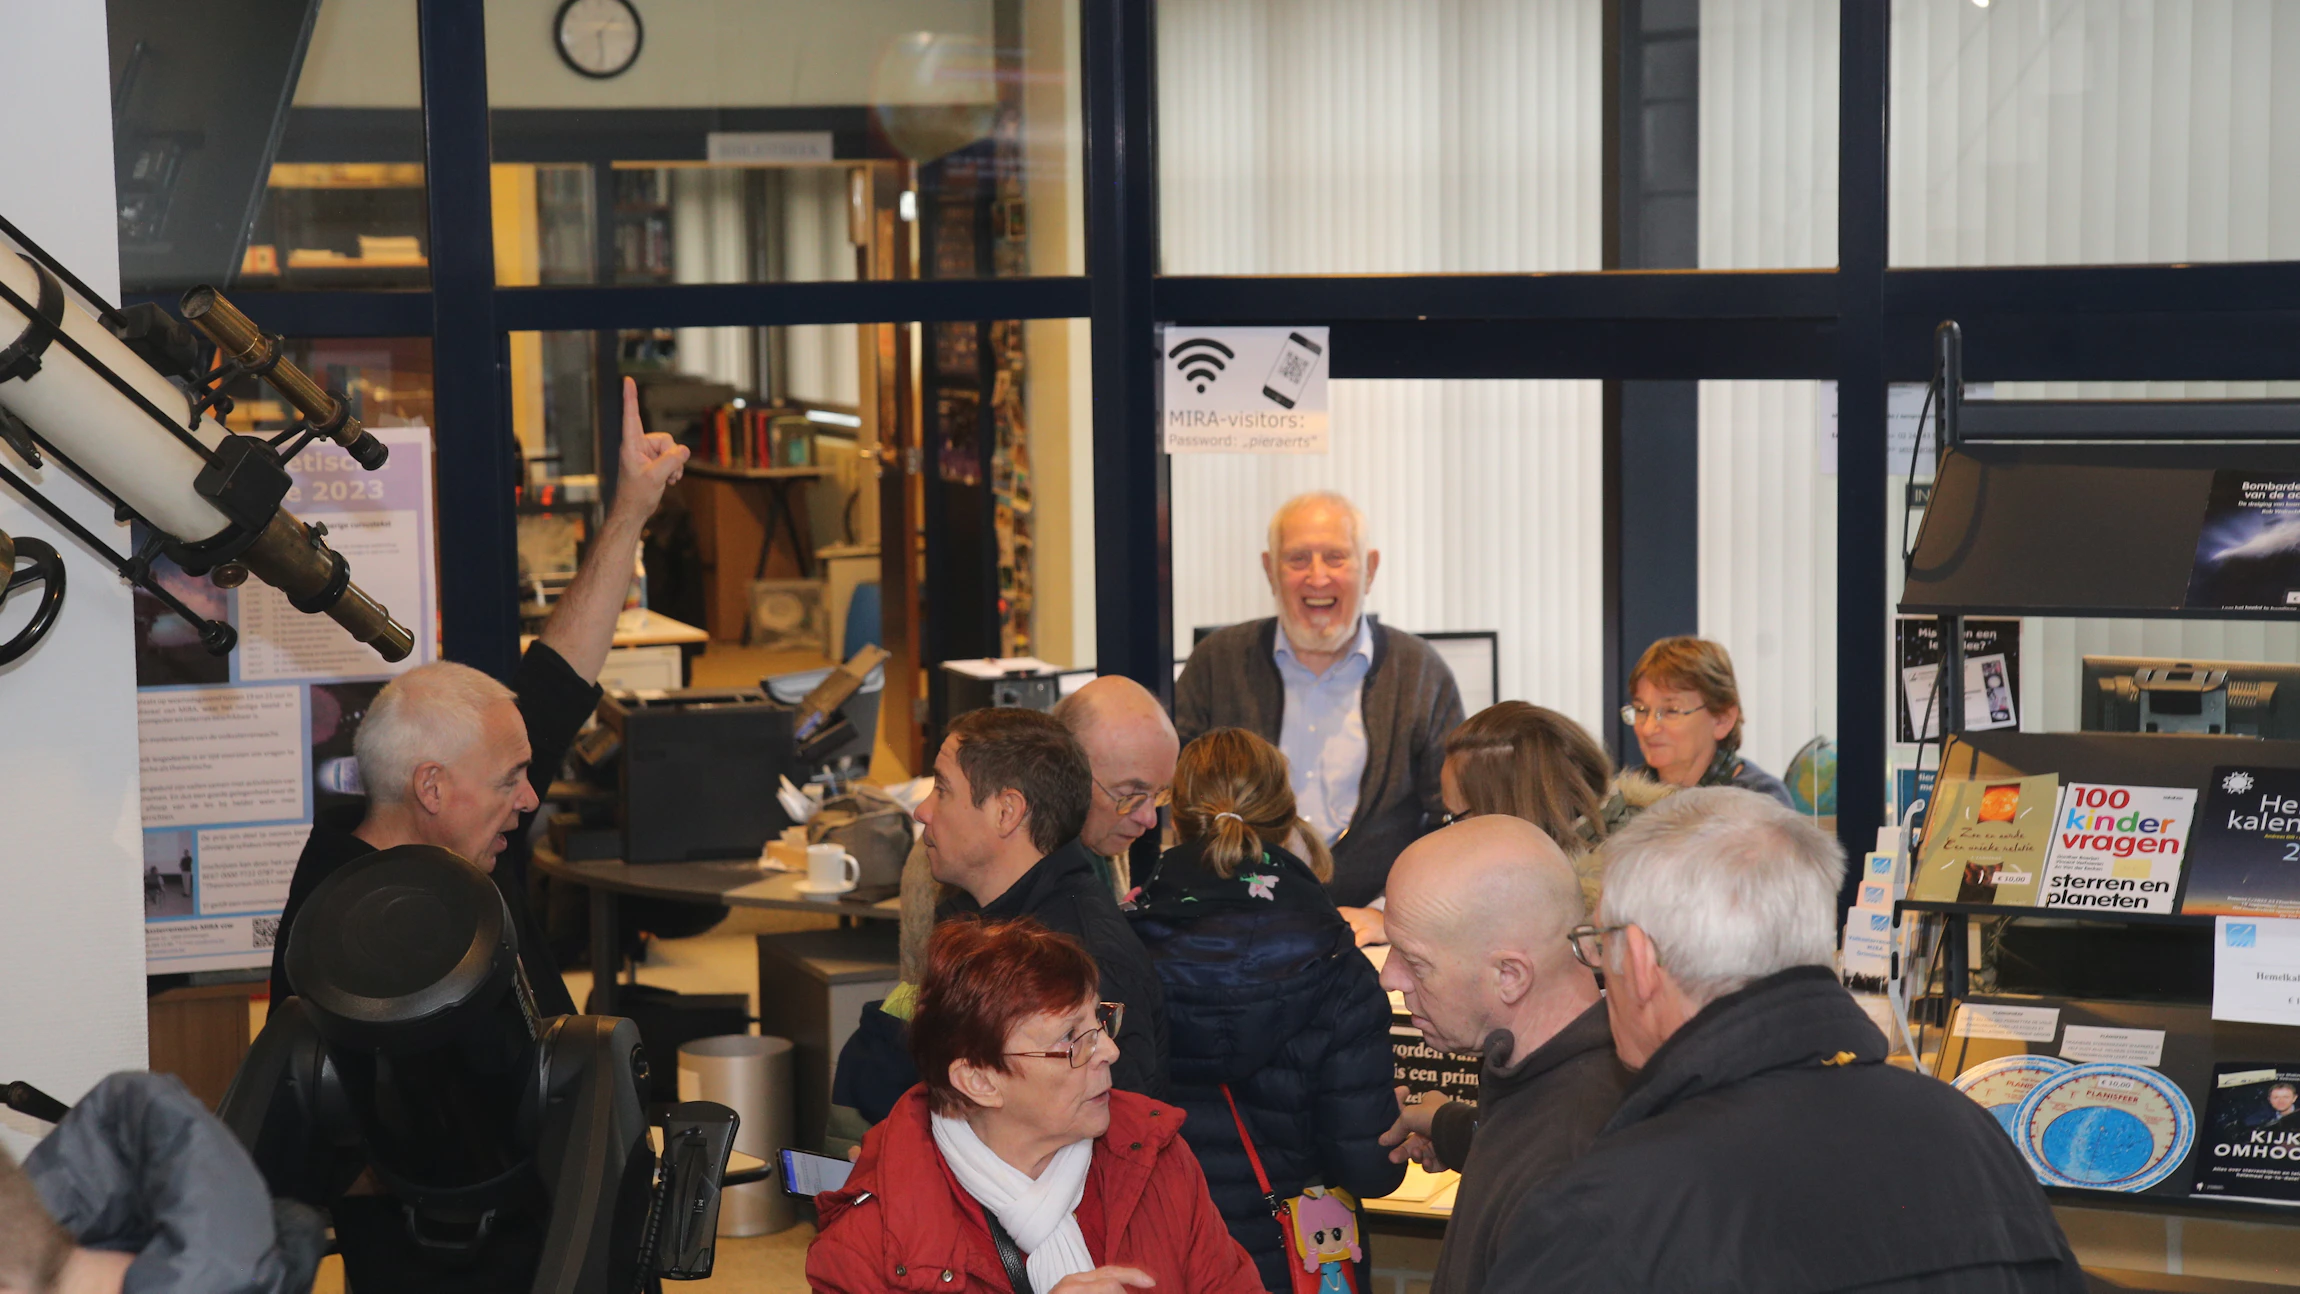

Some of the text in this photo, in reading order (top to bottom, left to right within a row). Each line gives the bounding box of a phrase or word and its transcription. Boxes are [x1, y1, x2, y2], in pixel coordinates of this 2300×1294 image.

[1169, 410, 1305, 428] MIRA-visitors:
[1169, 434, 1238, 447] Password:
[312, 481, 385, 501] 2023
[2245, 491, 2266, 500] van
[2269, 490, 2284, 500] de
[2074, 787, 2131, 809] 100
[2260, 793, 2300, 814] He
[2065, 807, 2175, 834] kinder
[2062, 833, 2180, 858] vragen
[2051, 873, 2170, 893] sterren en
[2046, 889, 2149, 909] planeten
[1409, 1067, 1438, 1082] een
[2108, 1080, 2132, 1089] 10,00
[2086, 1089, 2139, 1104] PLANISFEER
[2250, 1129, 2300, 1146] KIJK
